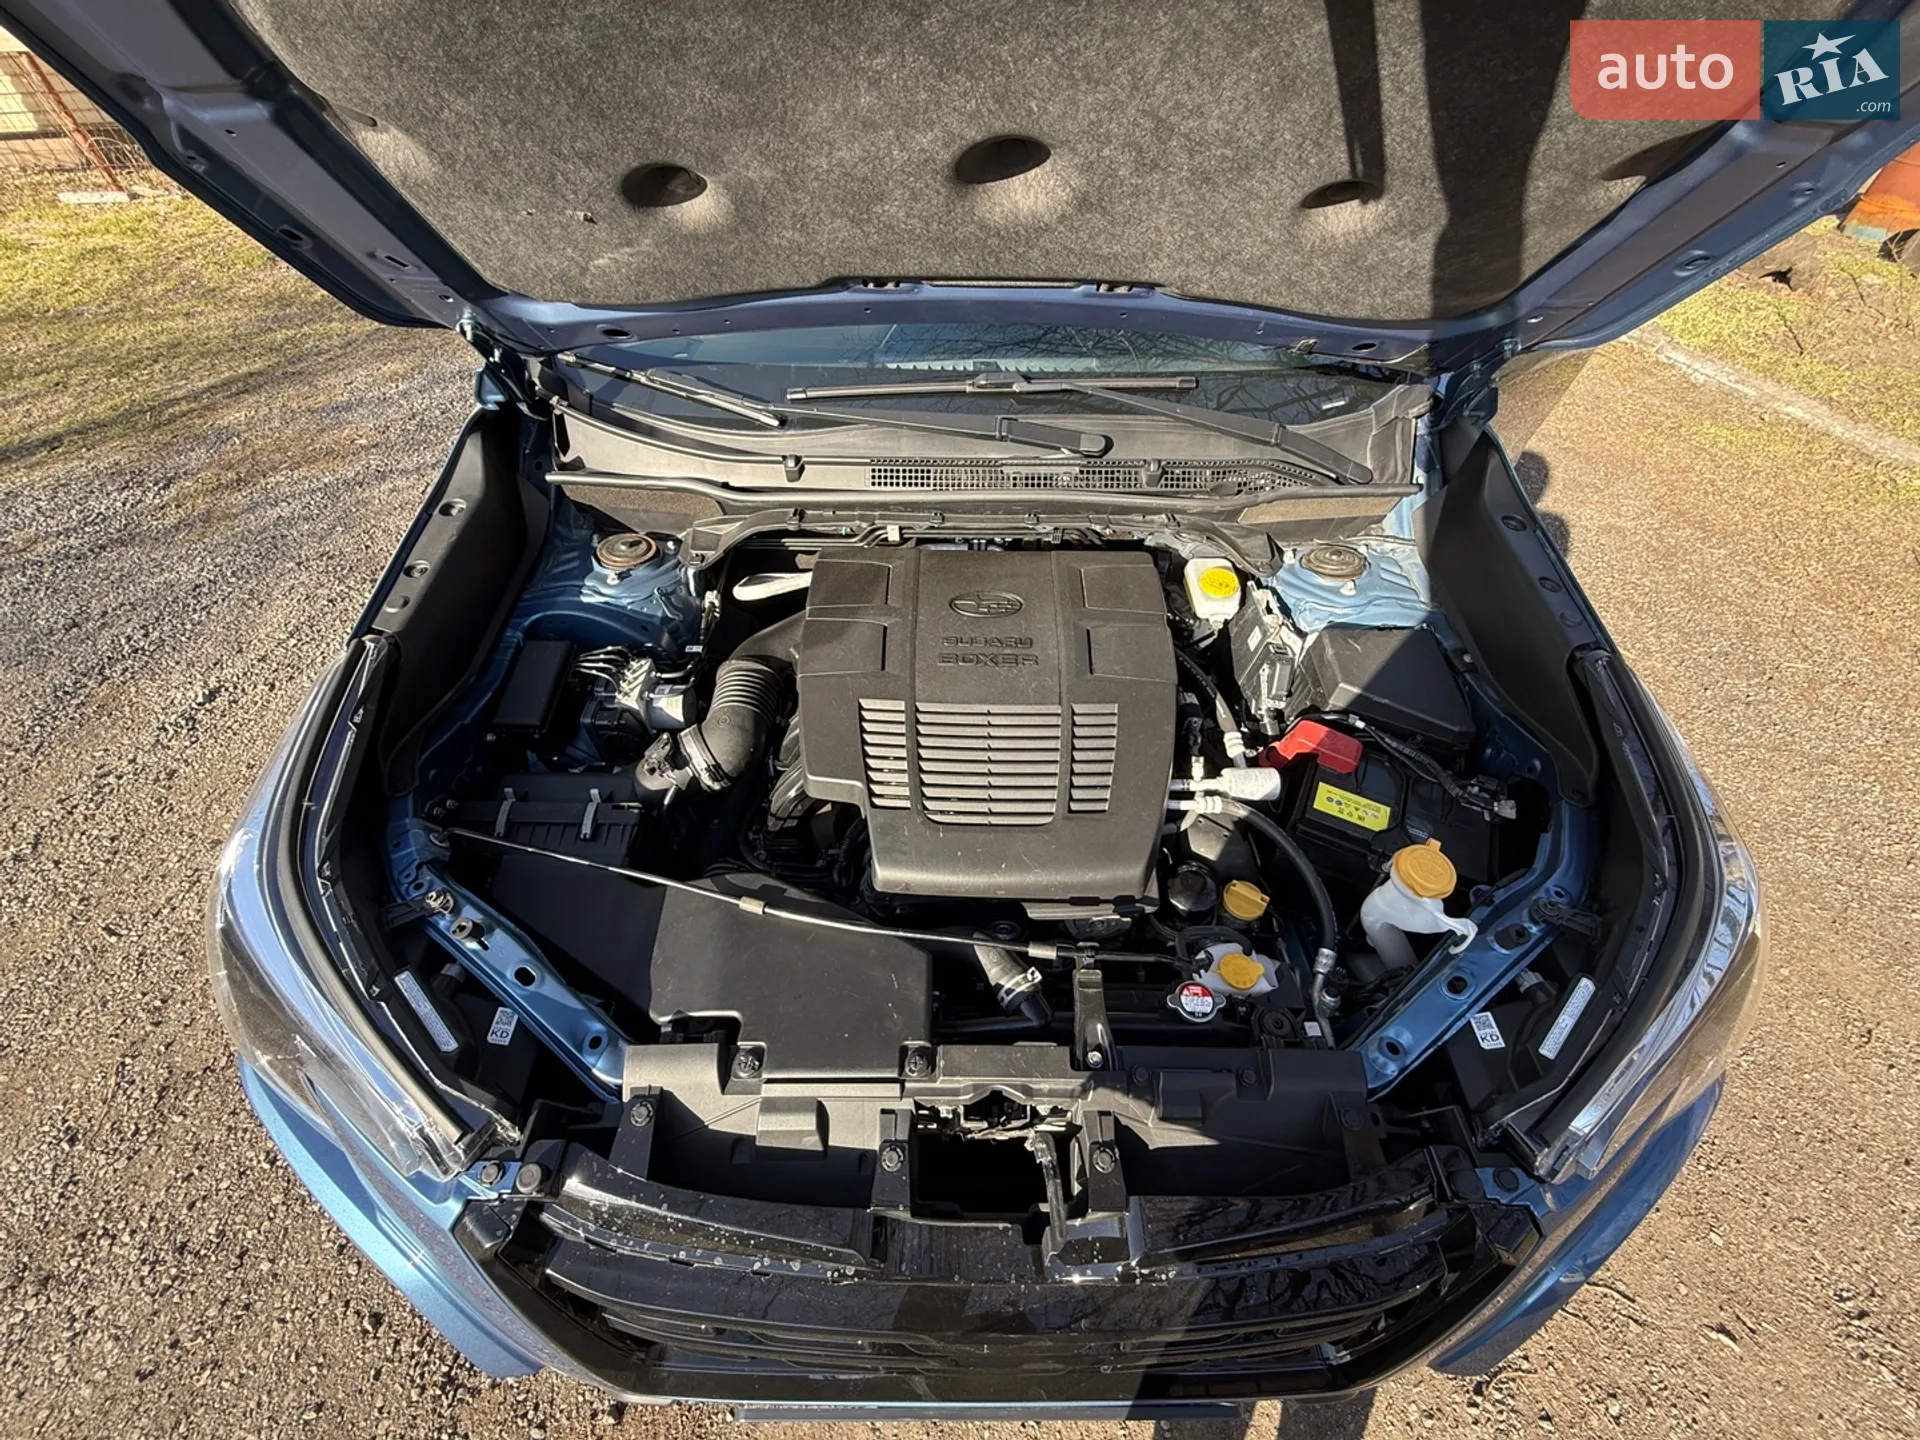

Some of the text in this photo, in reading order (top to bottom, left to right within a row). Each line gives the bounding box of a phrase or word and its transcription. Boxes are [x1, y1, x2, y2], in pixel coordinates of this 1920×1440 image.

[941, 635, 1034, 649] SUBARU
[937, 652, 1040, 667] BOXER
[490, 1029, 510, 1039] KD
[1480, 1034, 1500, 1044] KD
